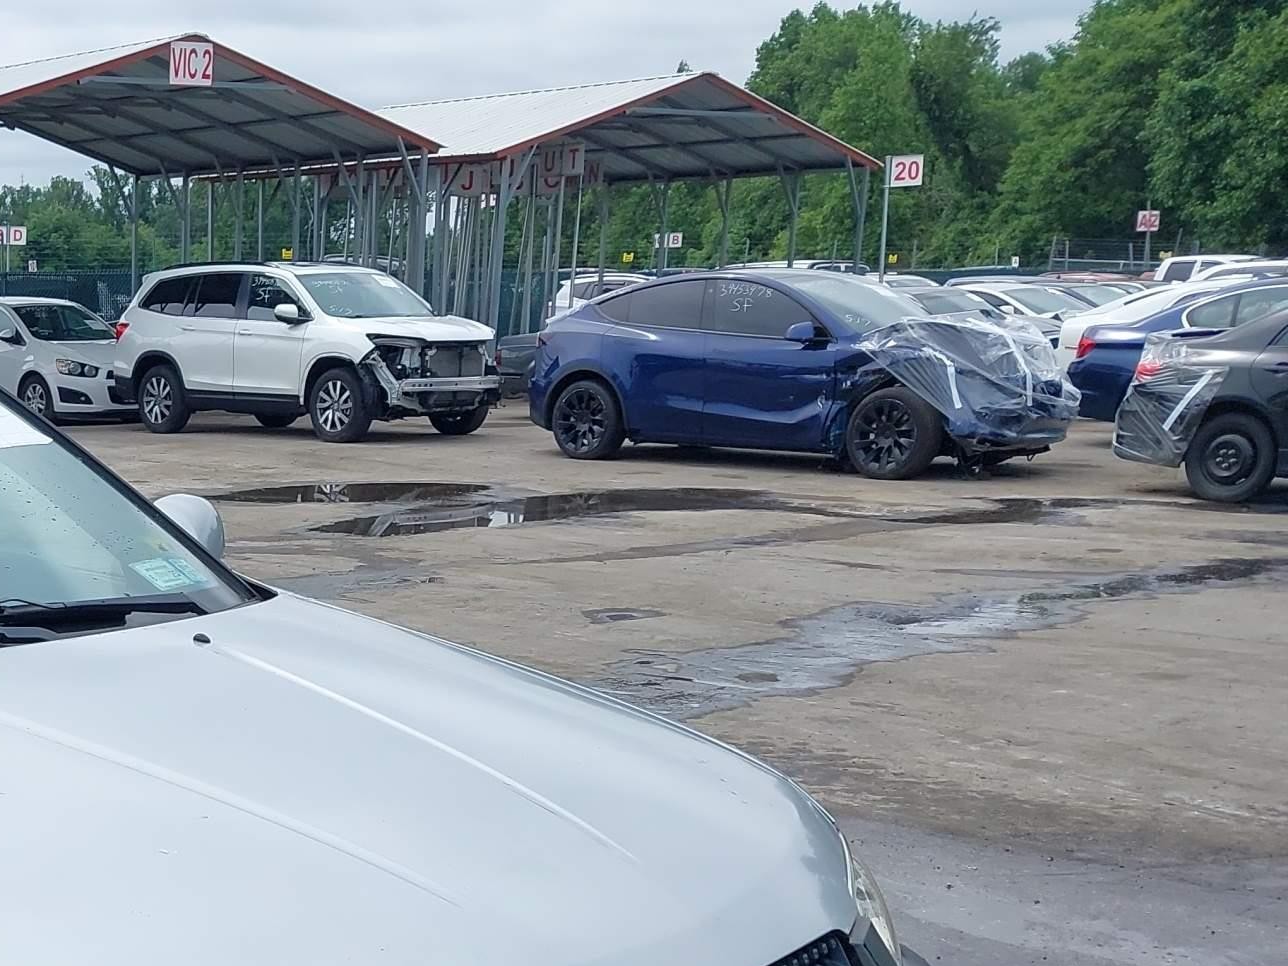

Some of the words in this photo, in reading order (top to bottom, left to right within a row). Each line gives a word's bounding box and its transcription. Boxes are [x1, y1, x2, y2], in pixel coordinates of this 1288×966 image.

[172, 47, 198, 80] VIC
[201, 48, 212, 80] 2
[569, 148, 579, 170] T
[893, 160, 920, 181] 20
[13, 229, 23, 241] D
[672, 235, 680, 245] B
